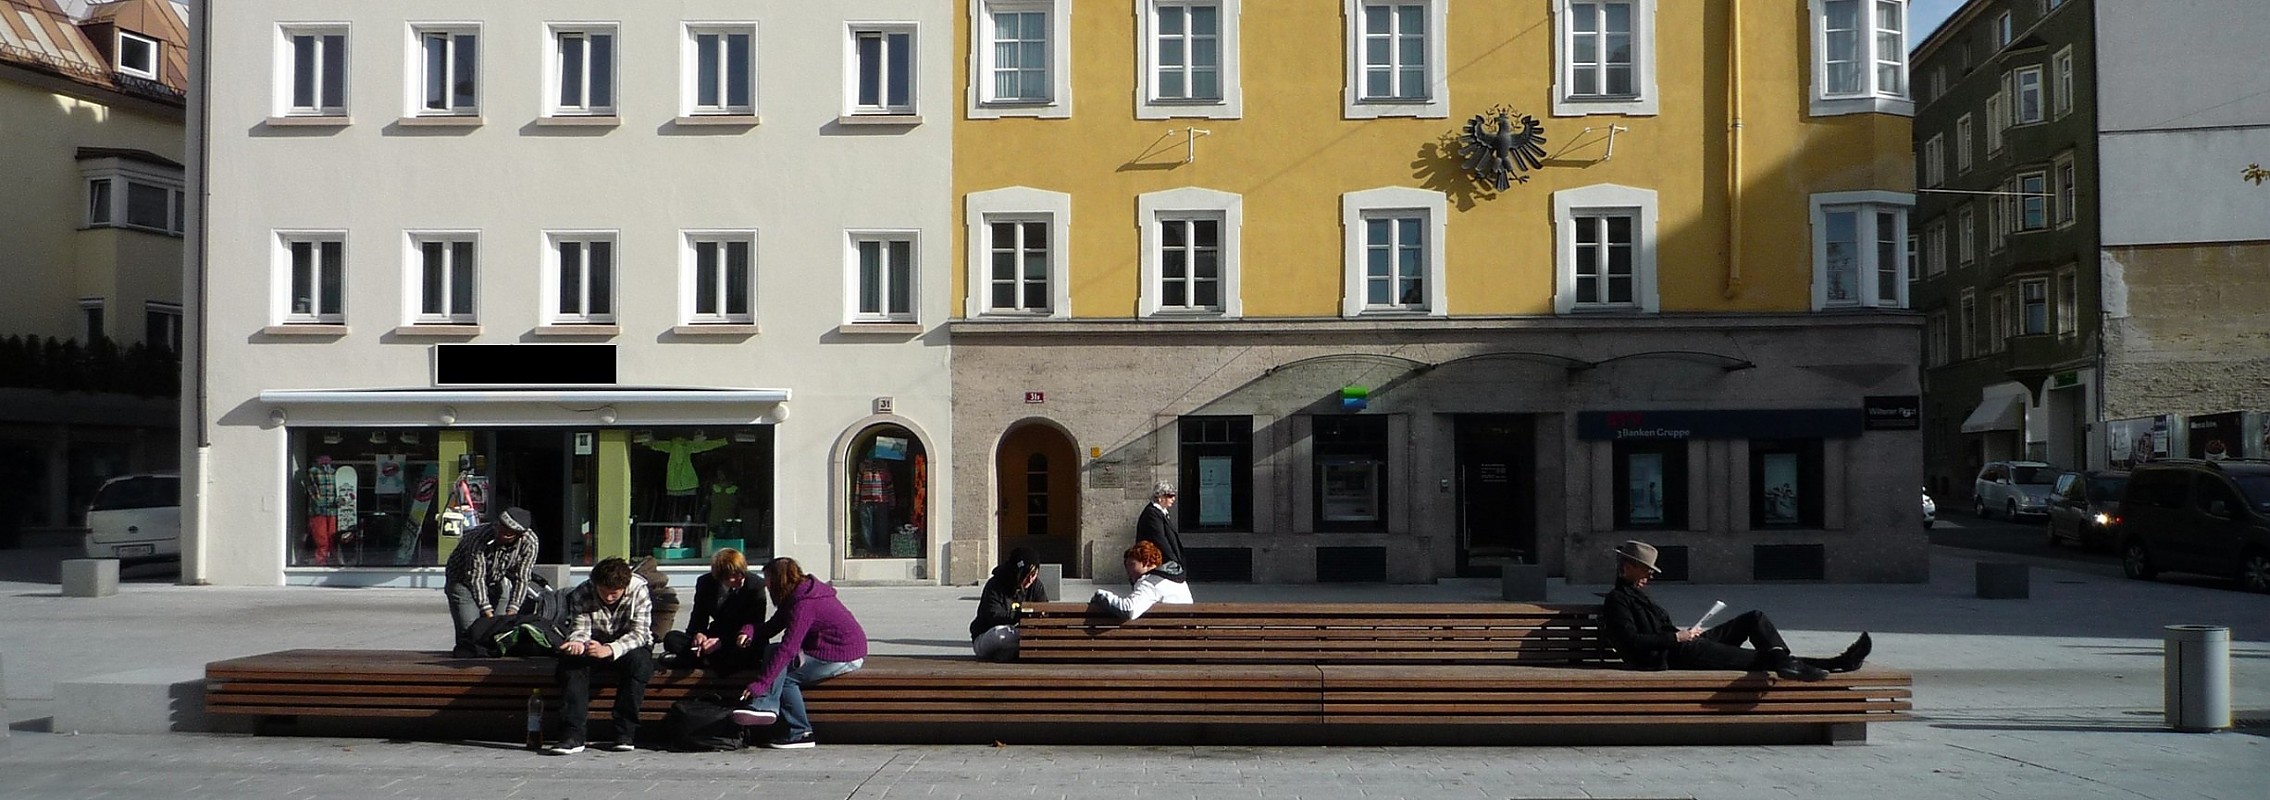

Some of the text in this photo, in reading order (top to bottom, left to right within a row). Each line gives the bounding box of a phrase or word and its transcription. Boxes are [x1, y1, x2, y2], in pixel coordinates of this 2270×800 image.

[880, 400, 890, 408] 31
[1616, 428, 1690, 439] 3 Banken Gruppe
